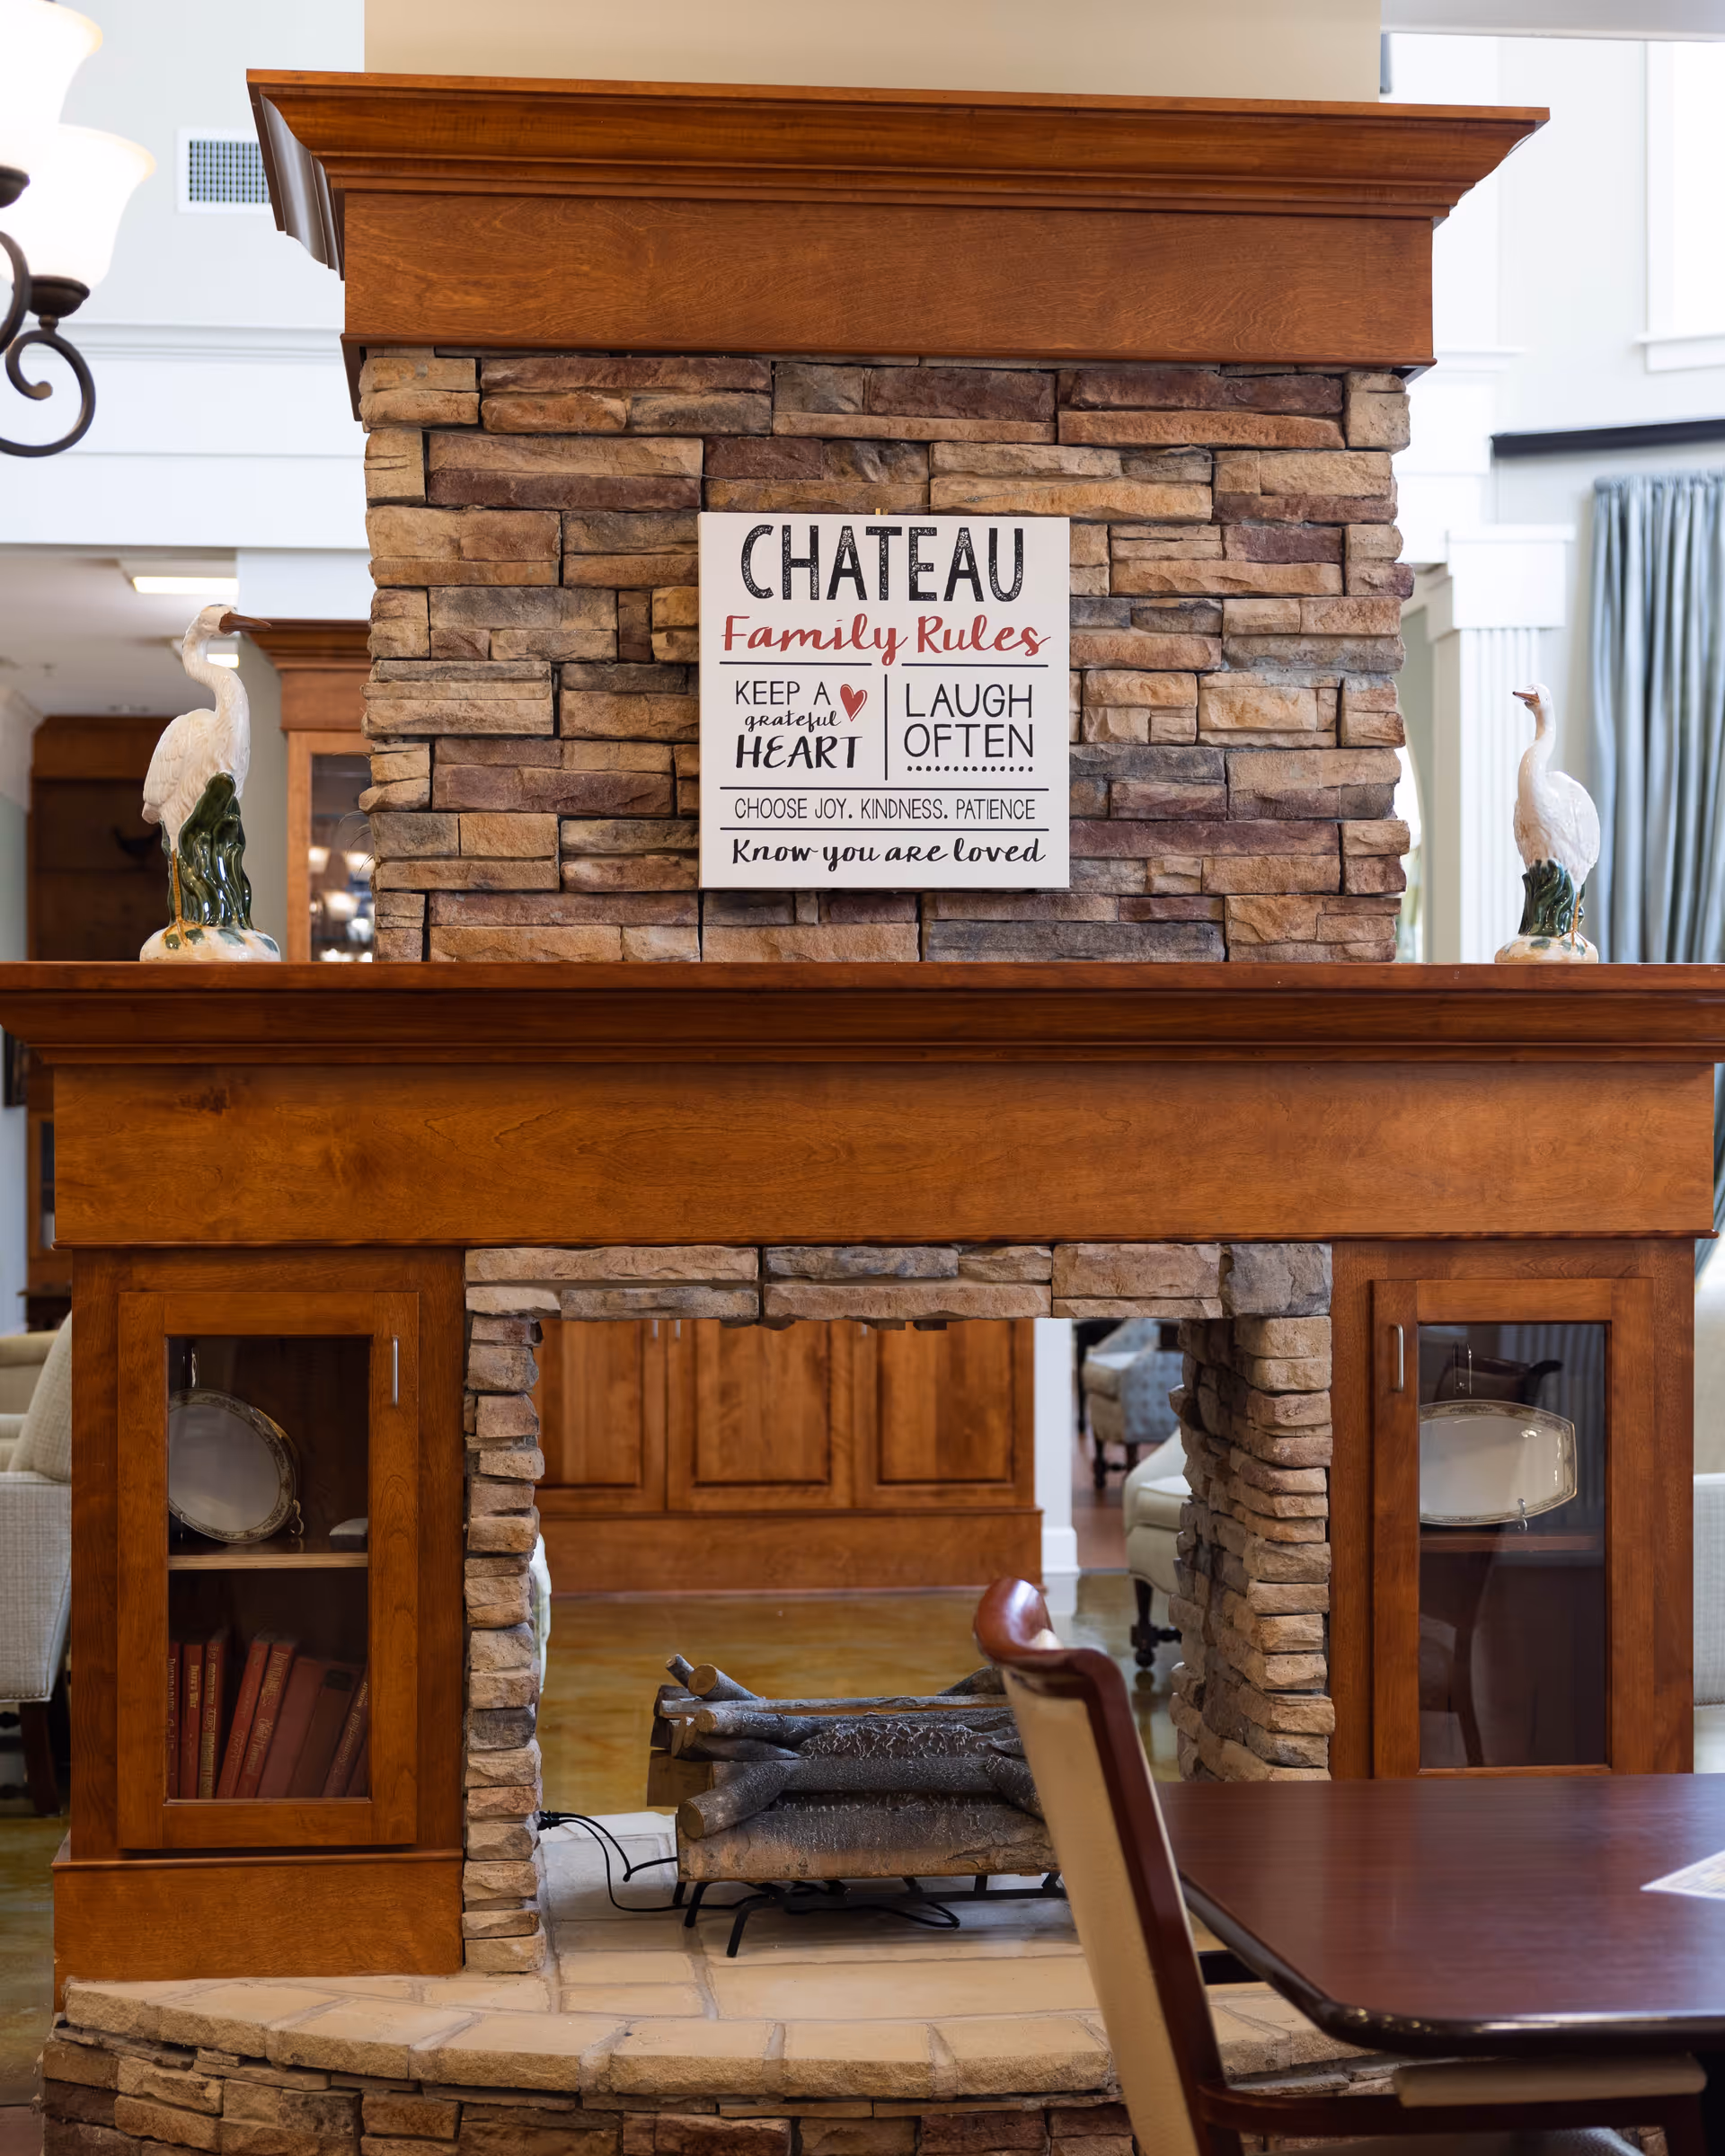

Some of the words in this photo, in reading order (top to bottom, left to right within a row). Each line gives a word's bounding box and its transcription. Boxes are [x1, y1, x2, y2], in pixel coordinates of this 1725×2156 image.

[741, 525, 1023, 602] CHATEAU
[721, 613, 908, 666] Family
[917, 614, 1051, 657] Rules
[736, 680, 801, 705] KEEP
[813, 681, 831, 706] A
[907, 684, 1032, 718] LAUGH
[745, 710, 841, 733] grateful
[735, 735, 863, 770] HEART
[904, 723, 1033, 758] OFTEN
[735, 798, 807, 819] CHOOSE
[815, 798, 853, 819] JOY.
[861, 798, 949, 819] KINDNESS.
[957, 799, 1035, 820] PATIENCE
[733, 839, 818, 865] Know
[822, 846, 880, 872] you
[884, 844, 948, 863] are
[954, 837, 1047, 862] loved
